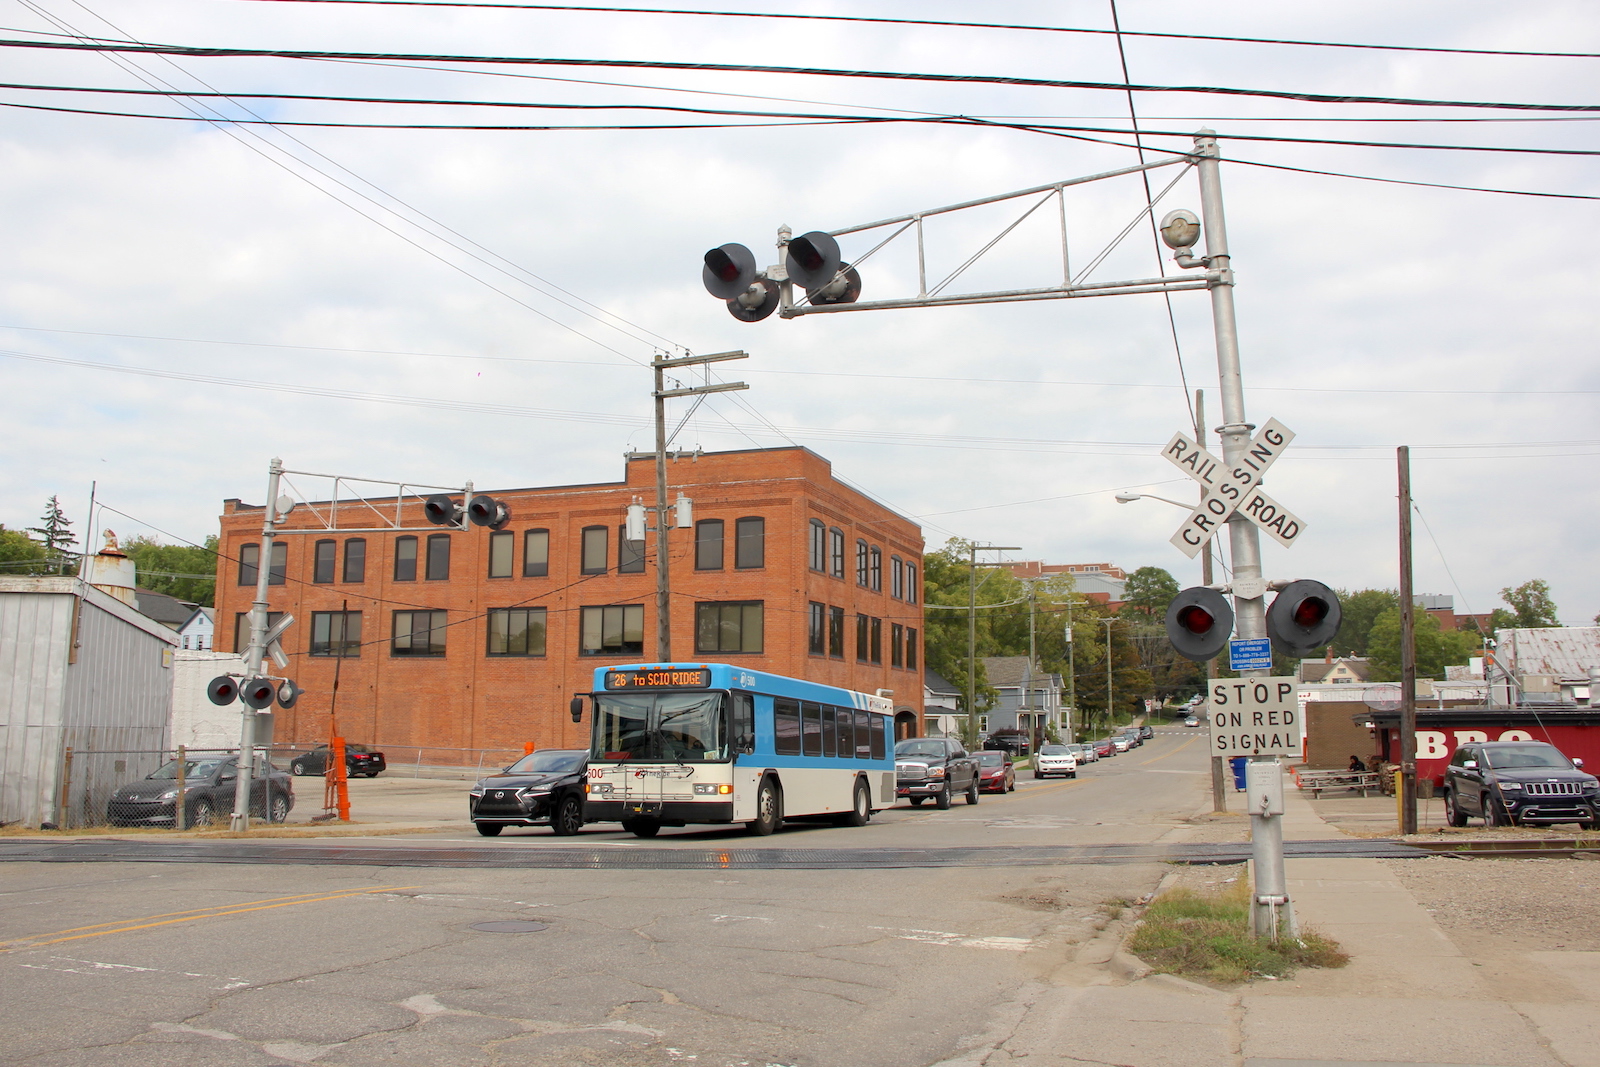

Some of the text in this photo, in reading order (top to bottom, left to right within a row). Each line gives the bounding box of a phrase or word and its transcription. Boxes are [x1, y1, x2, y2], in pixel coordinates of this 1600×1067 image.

[1168, 438, 1299, 540] RAIL ROAD
[1182, 429, 1284, 546] CROSSING
[614, 672, 701, 686] 26 to SCIO RIDGE
[1214, 683, 1292, 705] STOP
[1216, 711, 1294, 728] ON RED
[1217, 733, 1296, 750] SIGNAL
